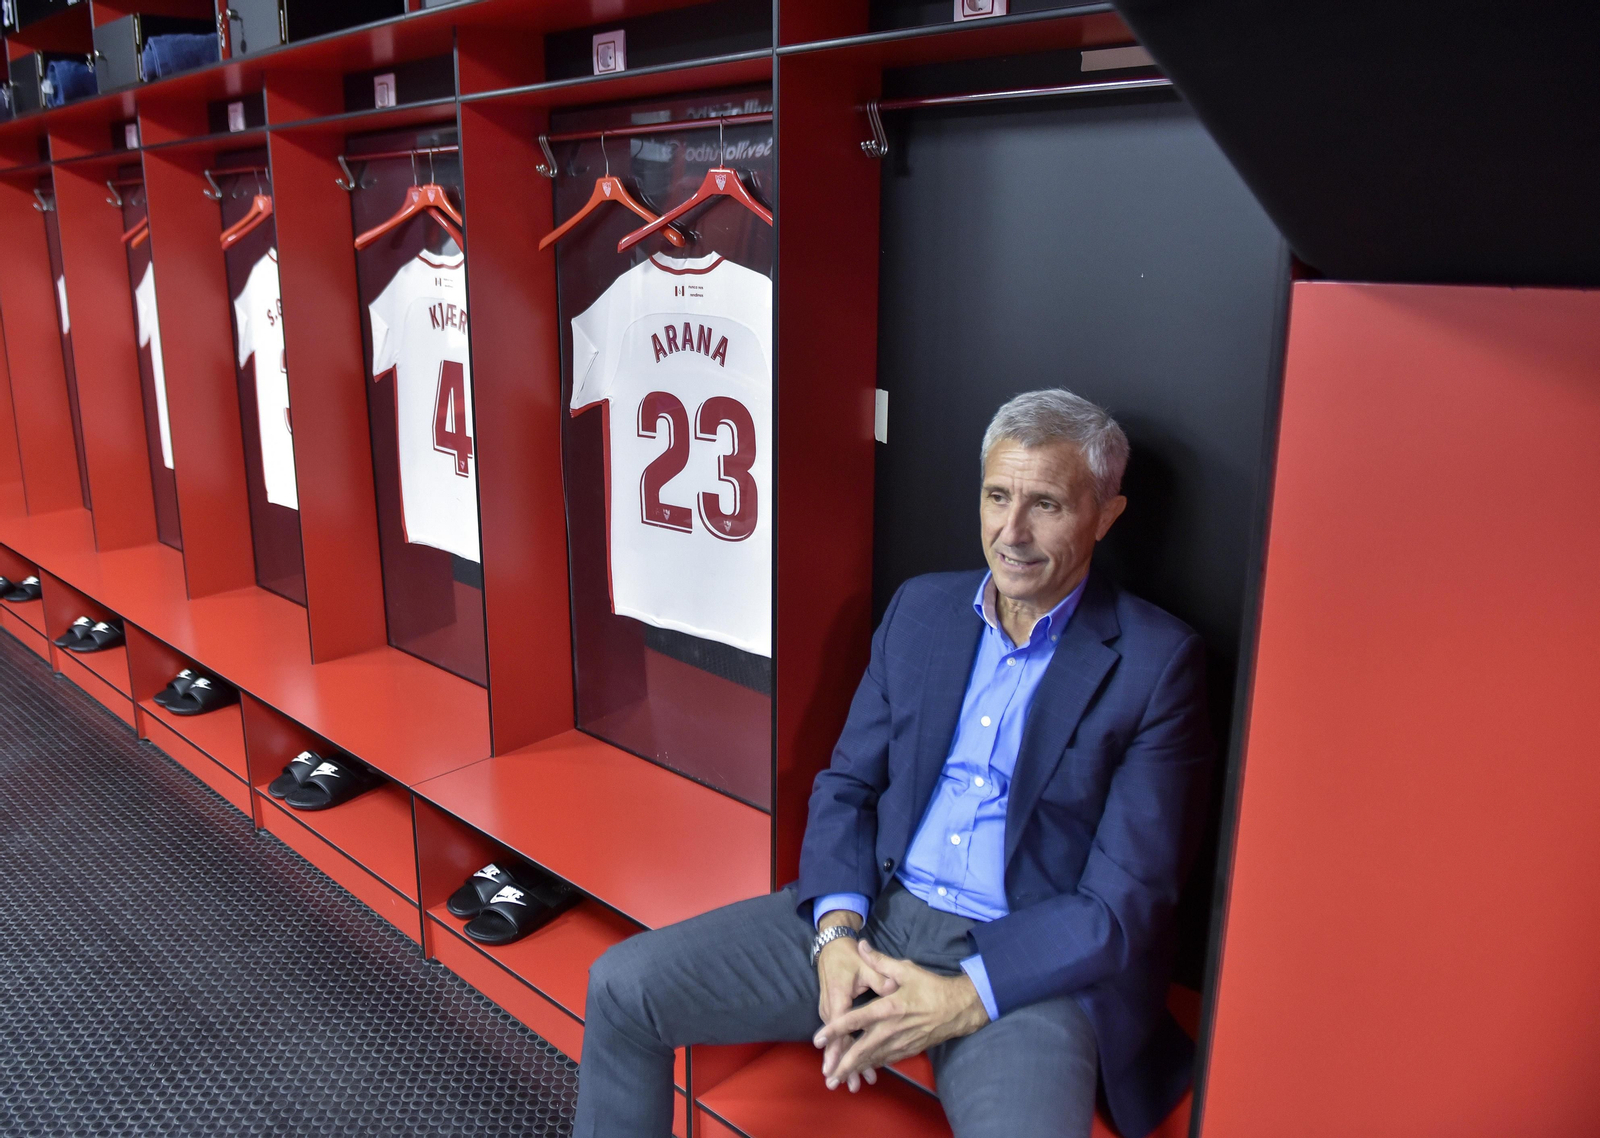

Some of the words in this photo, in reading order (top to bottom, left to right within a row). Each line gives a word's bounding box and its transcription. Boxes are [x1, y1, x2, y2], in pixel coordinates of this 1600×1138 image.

[429, 302, 468, 335] KJÆR
[651, 322, 729, 367] ARANA
[432, 360, 473, 478] 4
[637, 391, 758, 542] 23
